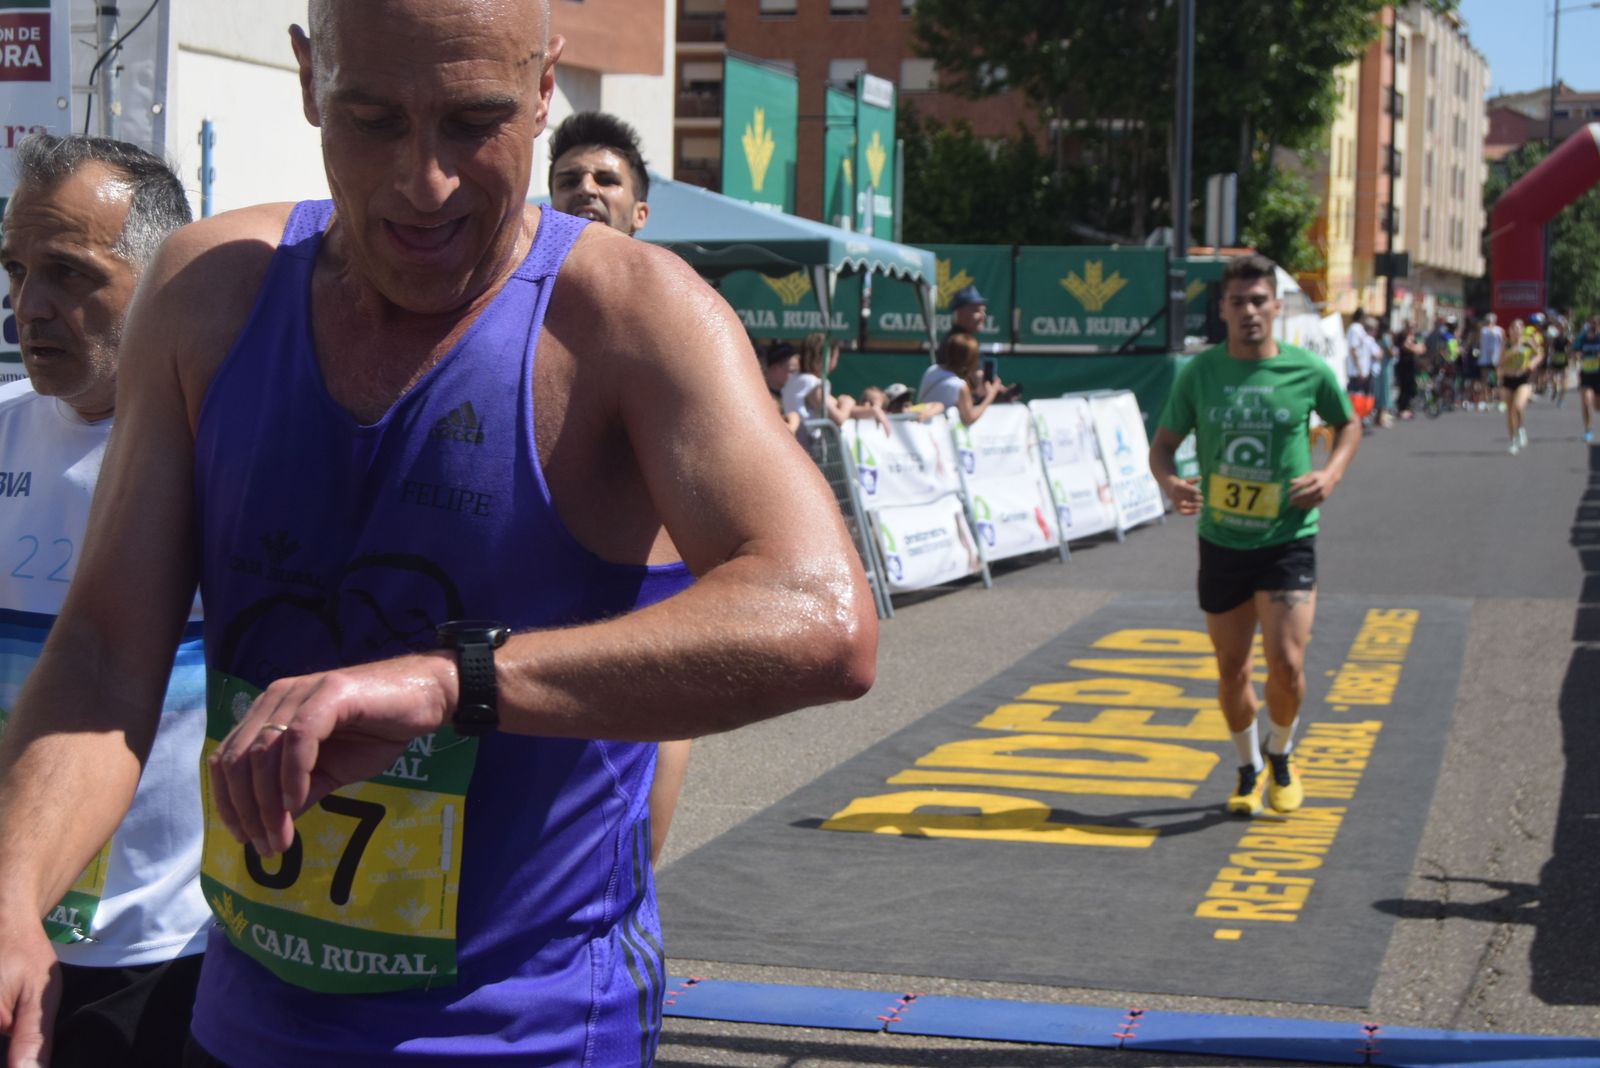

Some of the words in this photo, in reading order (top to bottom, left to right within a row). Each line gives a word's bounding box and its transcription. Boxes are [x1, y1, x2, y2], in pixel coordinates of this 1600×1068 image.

[0, 27, 14, 41] N
[18, 27, 41, 40] DE
[0, 44, 43, 67] RA
[1031, 316, 1081, 335] CAJA
[1085, 316, 1157, 336] RURAL
[401, 480, 492, 517] FELIPE
[1224, 482, 1263, 511] 37
[383, 756, 429, 781] AL
[1194, 806, 1347, 922] REFORMA
[47, 905, 82, 928] AL
[251, 924, 314, 966] CAJA
[320, 943, 438, 975] RURAL
